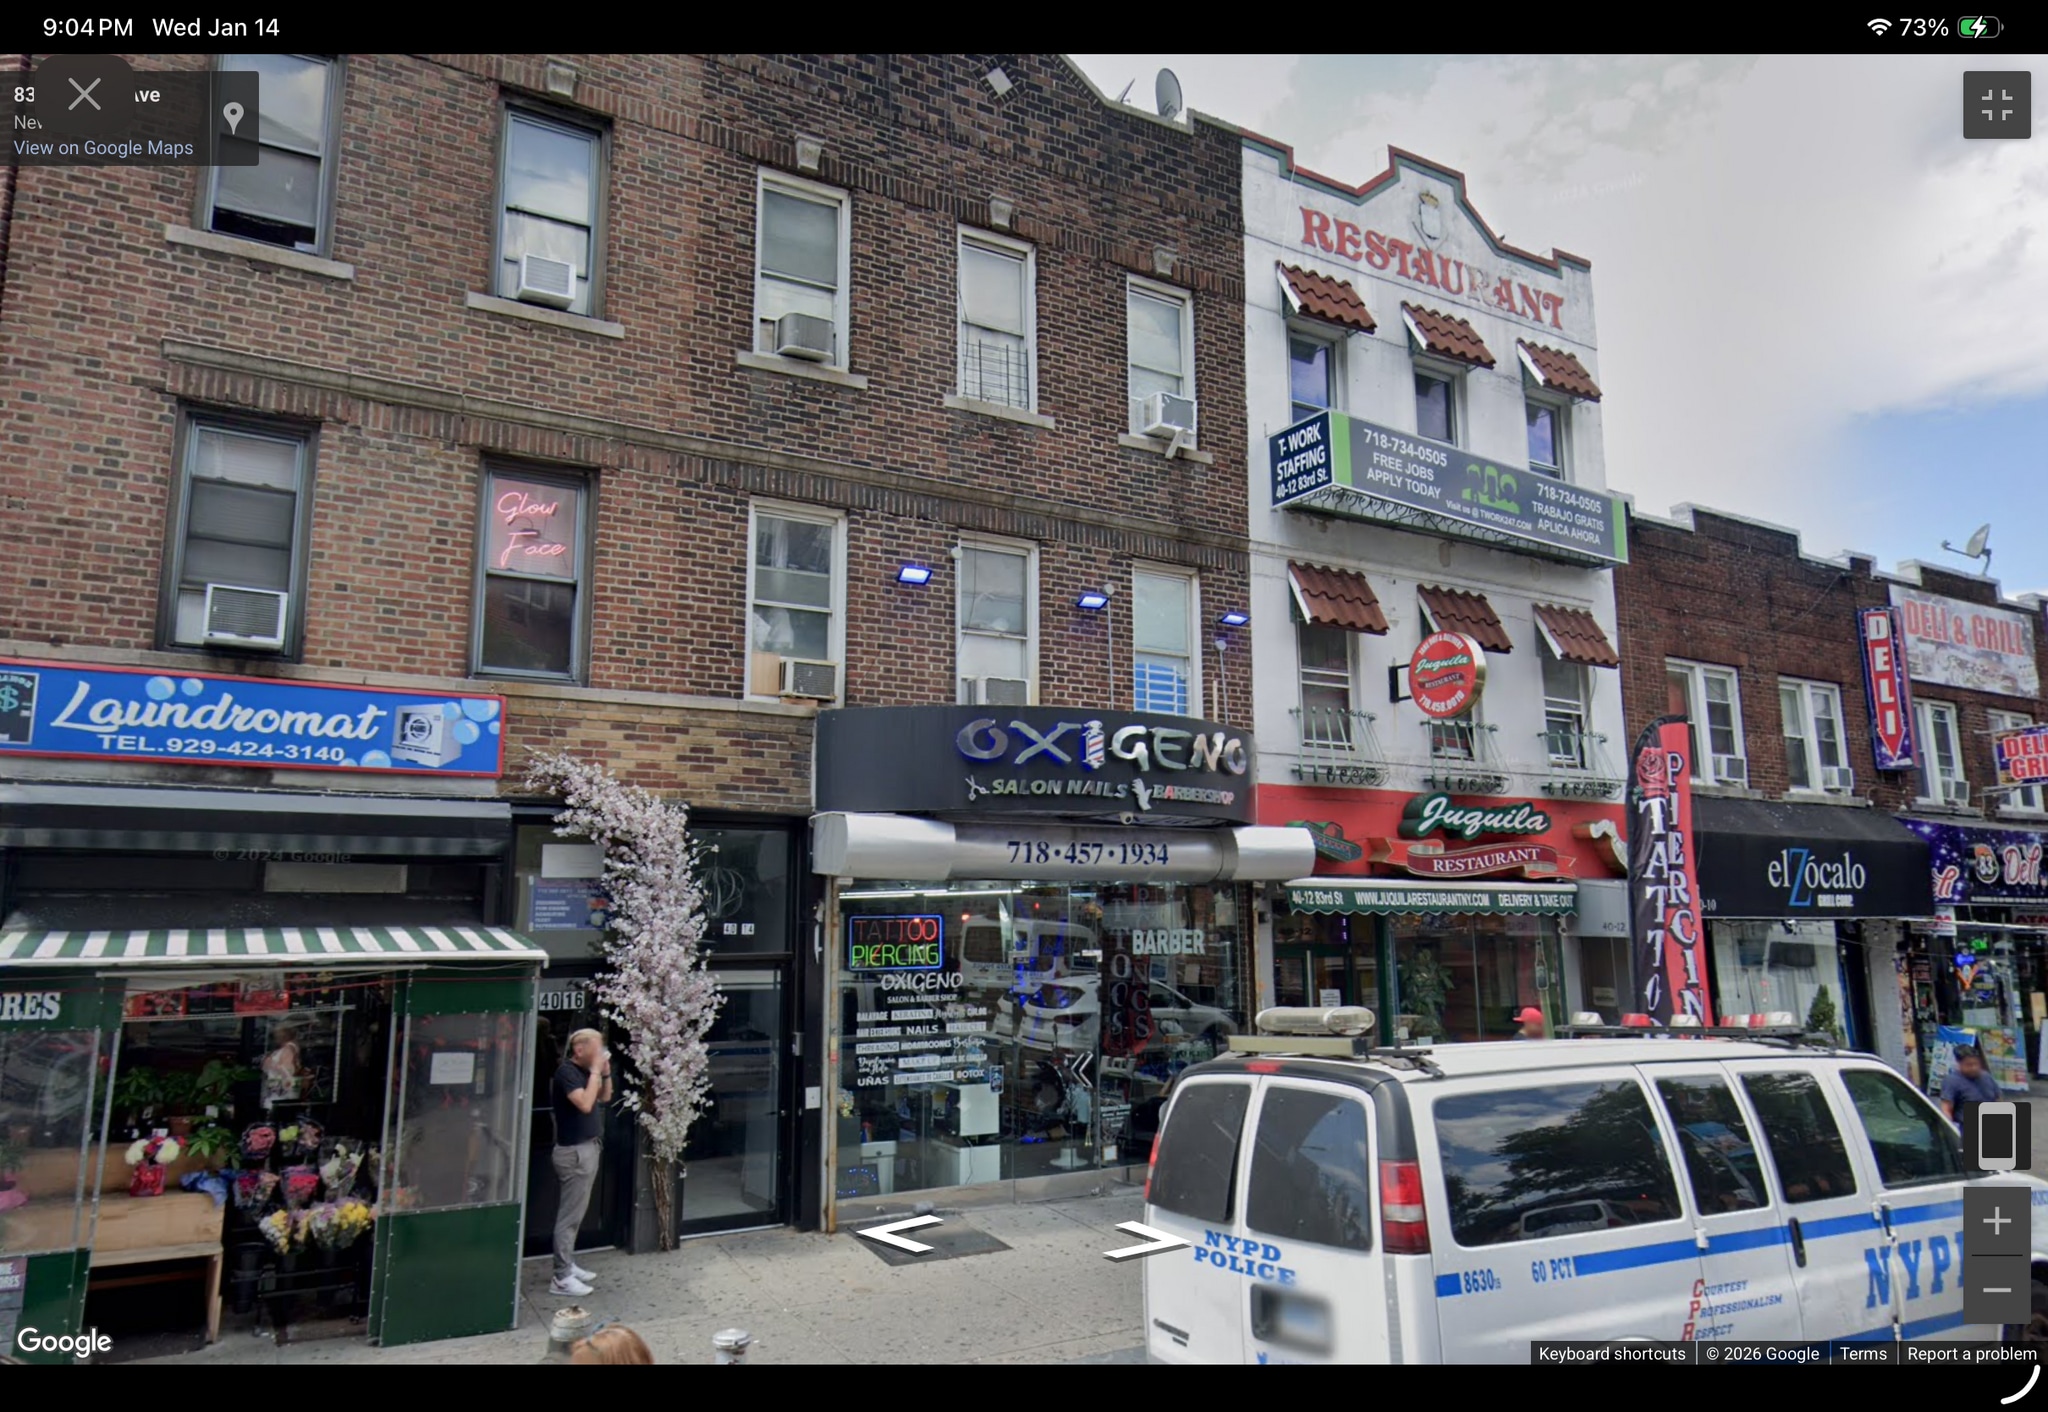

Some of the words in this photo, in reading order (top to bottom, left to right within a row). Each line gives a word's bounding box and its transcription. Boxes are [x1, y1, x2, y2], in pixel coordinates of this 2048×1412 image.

[1299, 205, 1564, 331] RESTAURANT
[1288, 422, 1321, 453] WORK
[1363, 428, 1448, 467] 718-734-0505
[1277, 445, 1325, 482] STAFFING
[1373, 452, 1402, 472] FREE
[1405, 461, 1434, 481] JOBS
[1276, 479, 1297, 500] 40-12
[1297, 472, 1316, 490] 83rd
[1366, 467, 1402, 488] APPLY
[1405, 478, 1442, 500] TODAY
[497, 492, 559, 525] Glow
[1445, 500, 1462, 513] Visit
[1462, 506, 1471, 515] us
[1536, 483, 1602, 514] 718-734-0505
[1531, 501, 1573, 523] TRABAJO
[1574, 513, 1604, 532] GRATIS
[1537, 518, 1570, 537] APLICA
[1570, 528, 1601, 546] AHORA
[501, 530, 567, 567] Face
[1903, 600, 1949, 643] DELI
[1953, 615, 1967, 645] &
[1970, 613, 2025, 656] GRILL
[1414, 654, 1469, 674] Juquila
[1868, 615, 1897, 736] DELI
[1425, 673, 1460, 688] RESTAURANT
[50, 681, 387, 740] Laundromat
[956, 718, 1247, 776] OXIGENO
[992, 779, 1062, 796] SALON
[1067, 780, 1128, 798] NAILS
[1152, 784, 1234, 805] BARBERSHOP
[1418, 797, 1548, 836] Juquila
[1433, 848, 1540, 872] RESTAURANT
[1980, 855, 1993, 875] 83
[1315, 891, 1333, 905] 83rd
[1498, 894, 1532, 907] DELIVERY
[1534, 895, 1540, 907] &
[1541, 894, 1559, 907] TAKE
[1560, 895, 1573, 908] OUT
[854, 918, 938, 941] TATTOO
[1602, 922, 1626, 932] 40-12
[852, 943, 939, 967] PIERCING
[1132, 929, 1206, 955] BARBER
[880, 972, 964, 992] OXIGENO
[0, 992, 61, 1021] RES
[887, 996, 910, 1004] SALON
[940, 994, 958, 1002] SHOP
[906, 1025, 938, 1035] NAILS
[857, 1043, 898, 1053] THREADING
[858, 1076, 889, 1086] UÑAS
[957, 1070, 984, 1079] BOTOX
[1205, 1229, 1282, 1262] NYPD
[1194, 1245, 1296, 1286] POLICE
[1532, 1261, 1546, 1283] 60
[1550, 1257, 1572, 1280] PCT
[1864, 1232, 1964, 1310] NYP
[1464, 1269, 1494, 1294] 8630
[1693, 1278, 1748, 1298] COURTESY
[1688, 1293, 1782, 1320] PROFESSIONALISM
[1682, 1322, 1734, 1341] RESPECT
